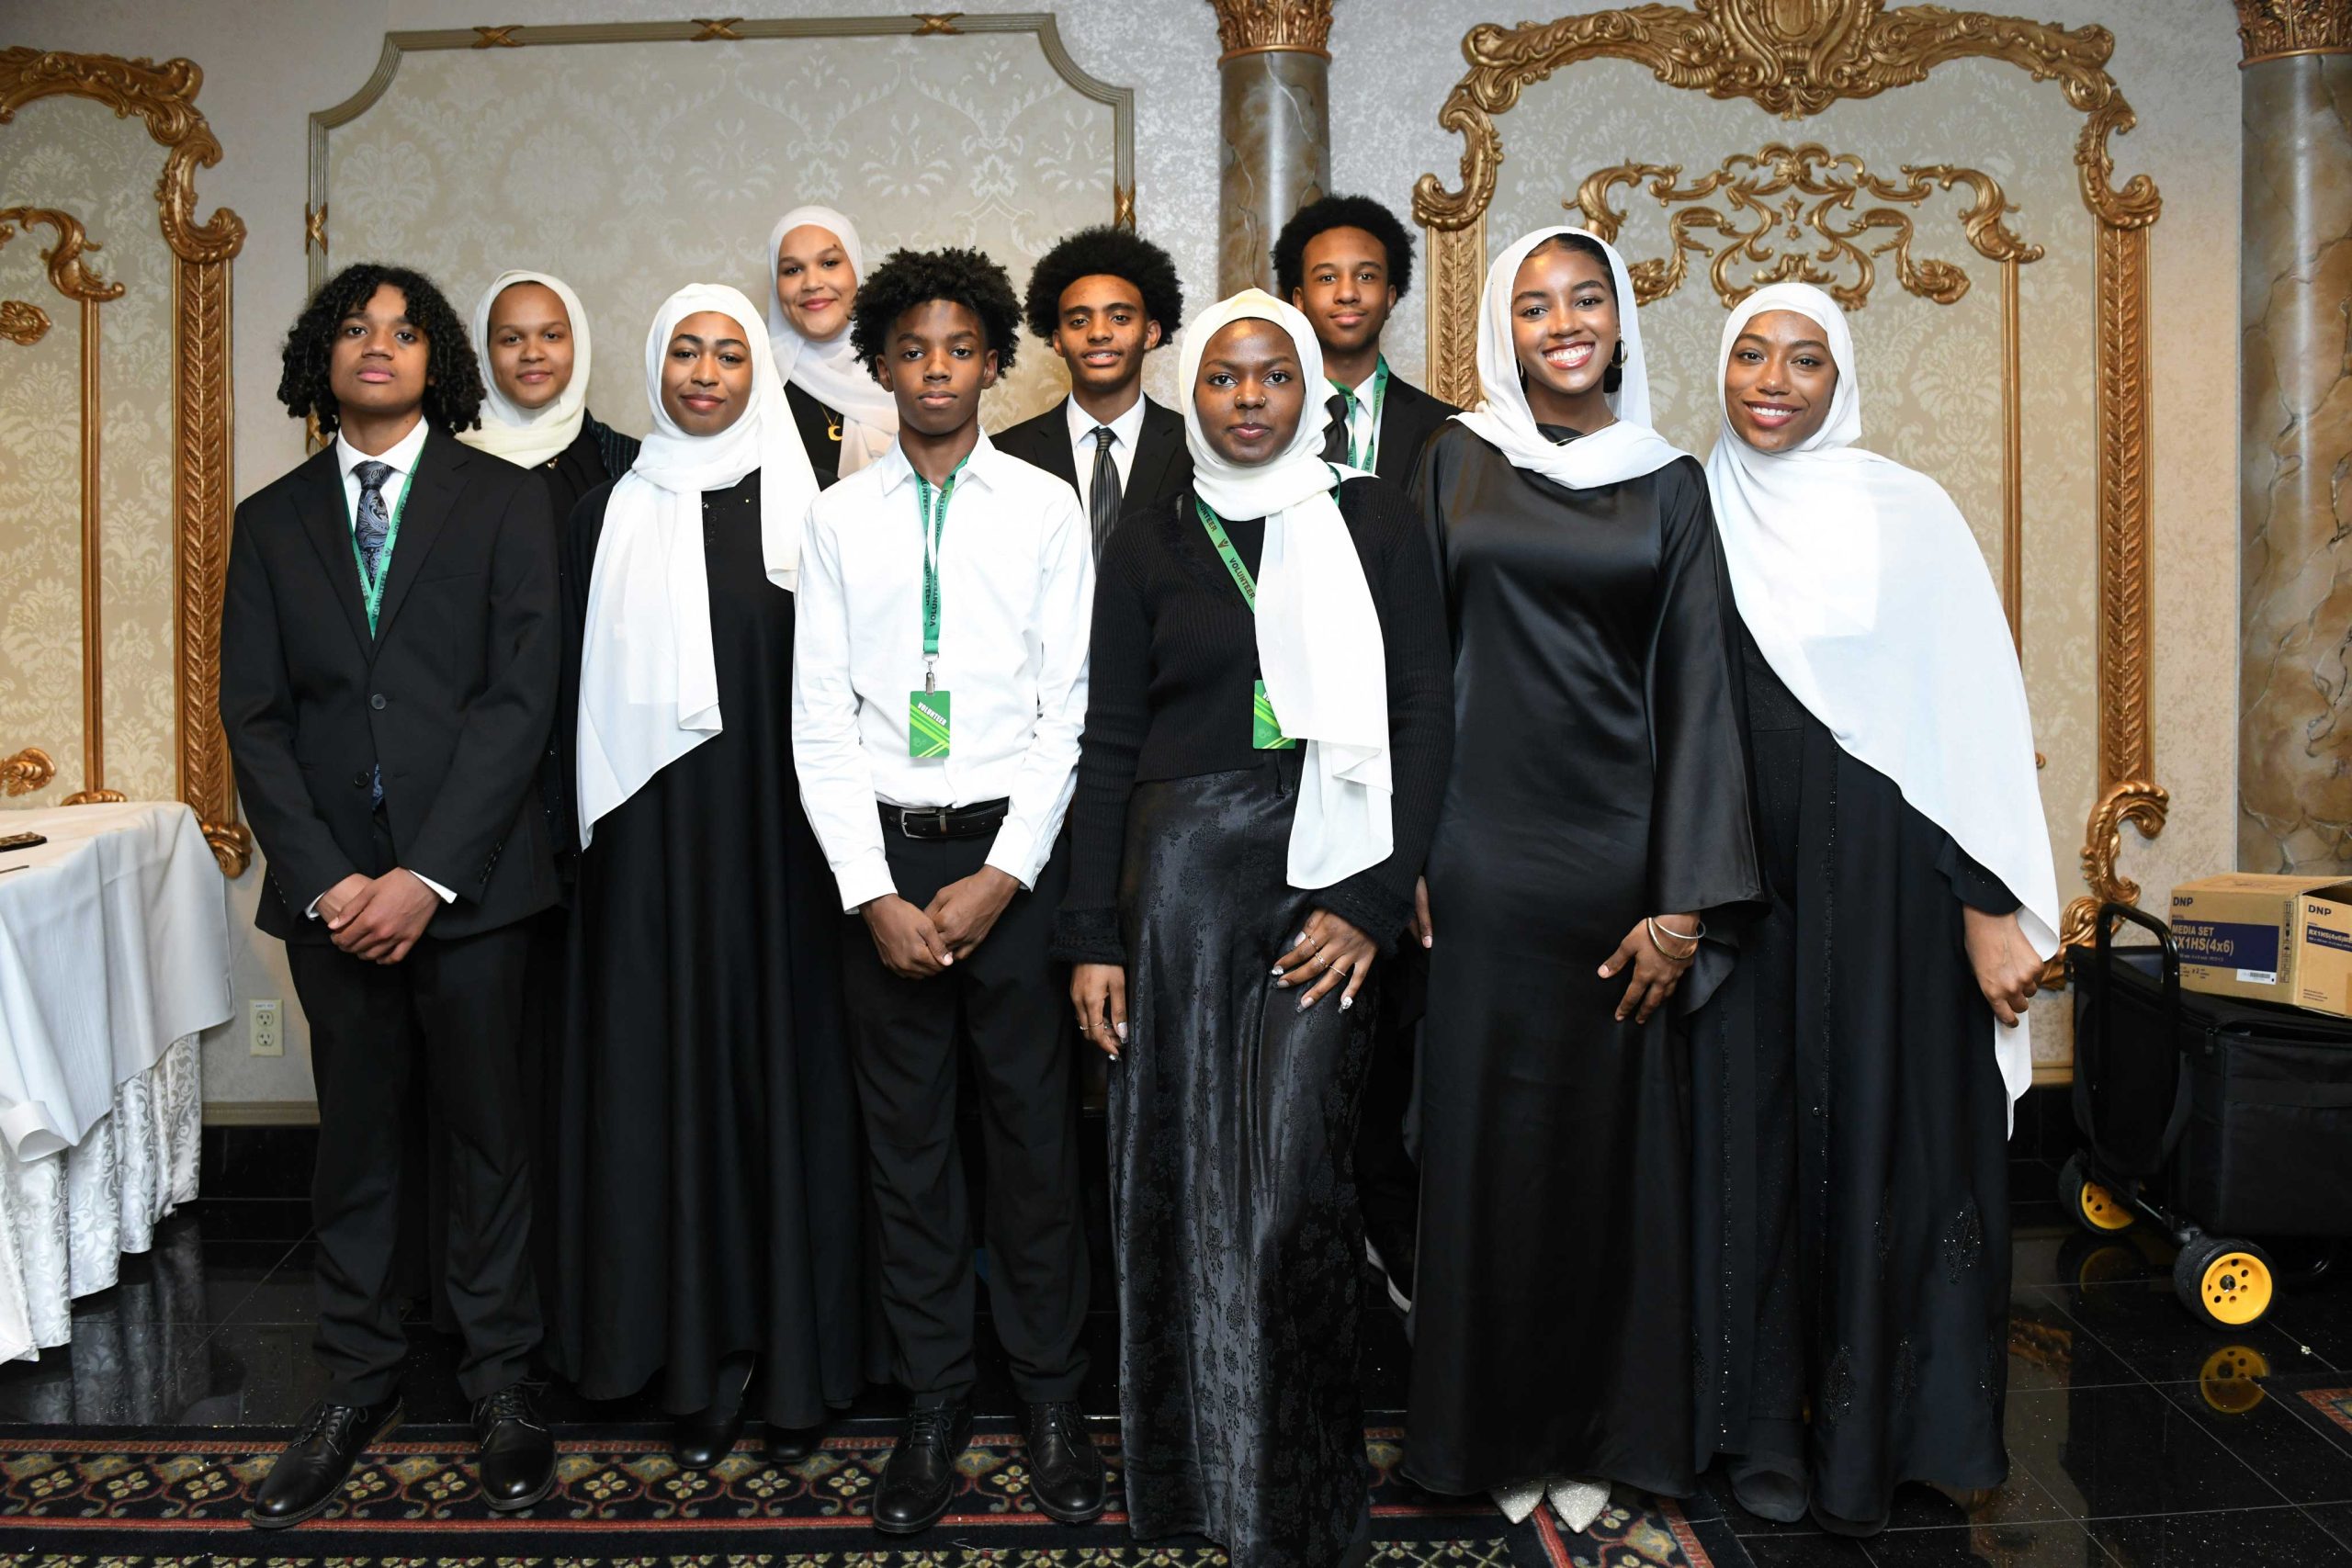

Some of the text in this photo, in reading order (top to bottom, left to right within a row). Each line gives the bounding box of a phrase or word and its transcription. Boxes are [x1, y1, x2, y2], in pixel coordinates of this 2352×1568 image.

[936, 489, 948, 537] VOLUNTEER
[372, 570, 388, 618] VOLUNTEER
[1229, 557, 1256, 600] VOLUNTEER
[930, 575, 938, 626] VOLUNTEER
[917, 701, 947, 726] VOLUNTEER
[2173, 897, 2193, 907] DNP
[2308, 905, 2332, 916] DNP
[2171, 924, 2214, 937] MEDIA SET
